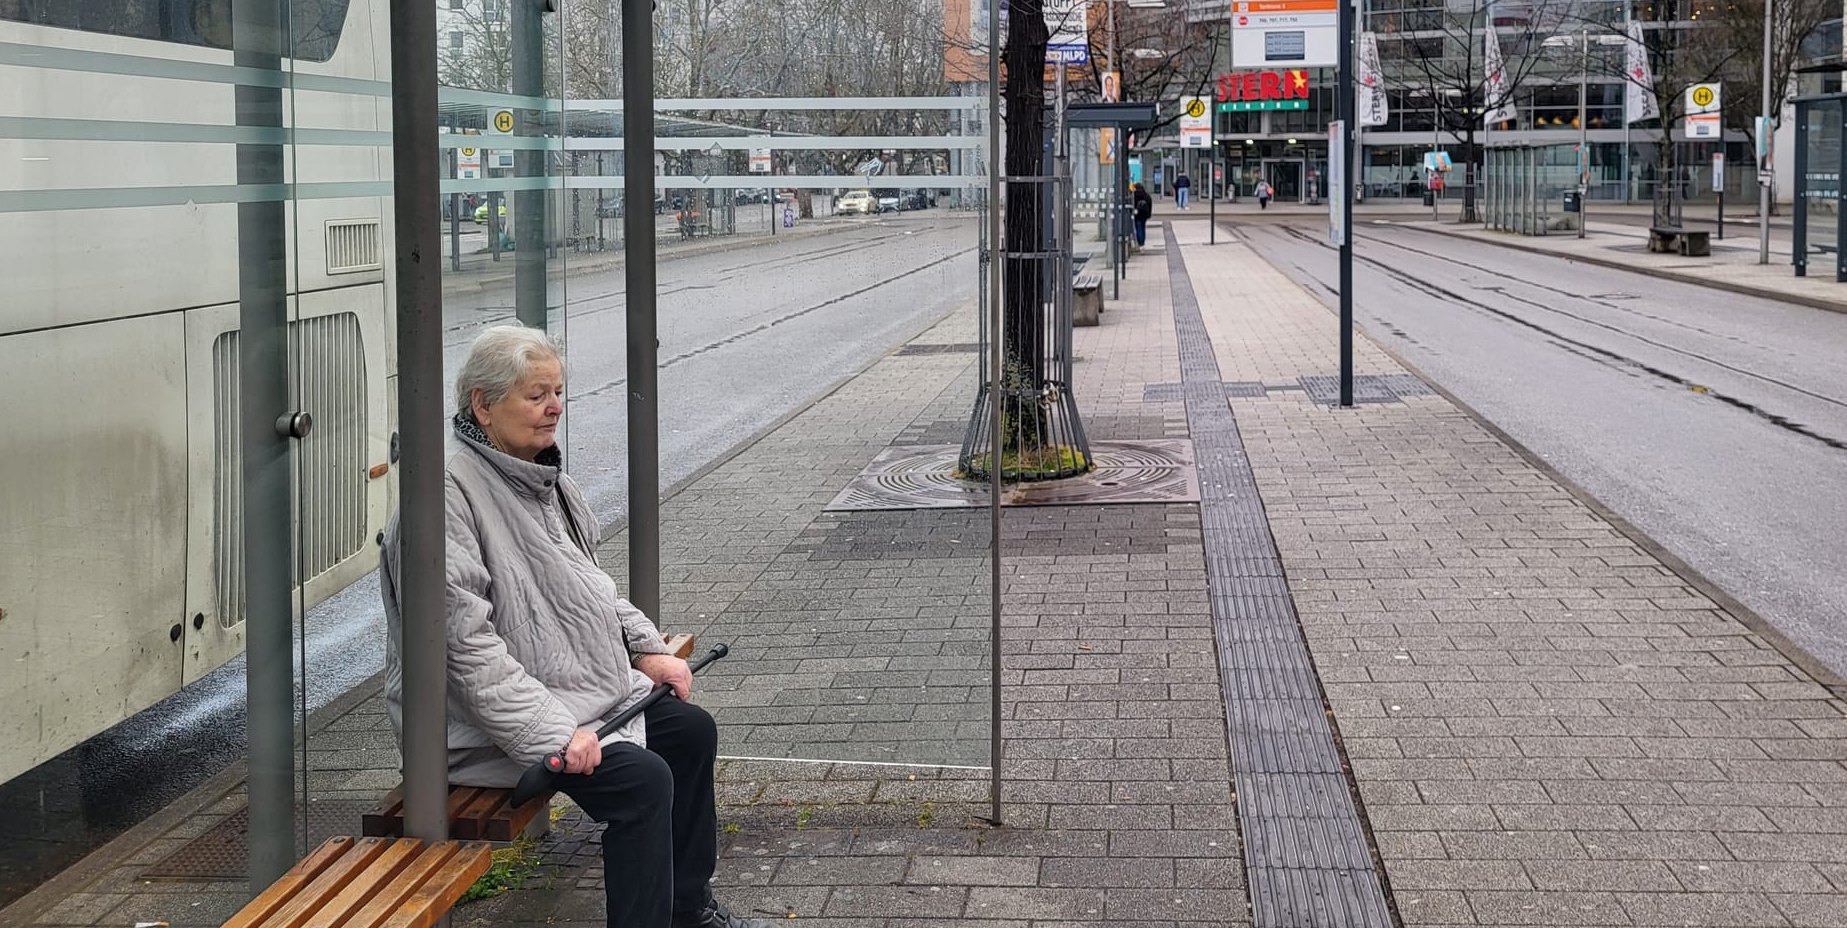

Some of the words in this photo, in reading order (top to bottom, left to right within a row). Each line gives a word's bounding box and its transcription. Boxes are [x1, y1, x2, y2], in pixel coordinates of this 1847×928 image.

[1063, 50, 1086, 61] MLPD
[1217, 70, 1309, 102] STERN
[1698, 91, 1708, 101] H
[500, 116, 510, 128] H
